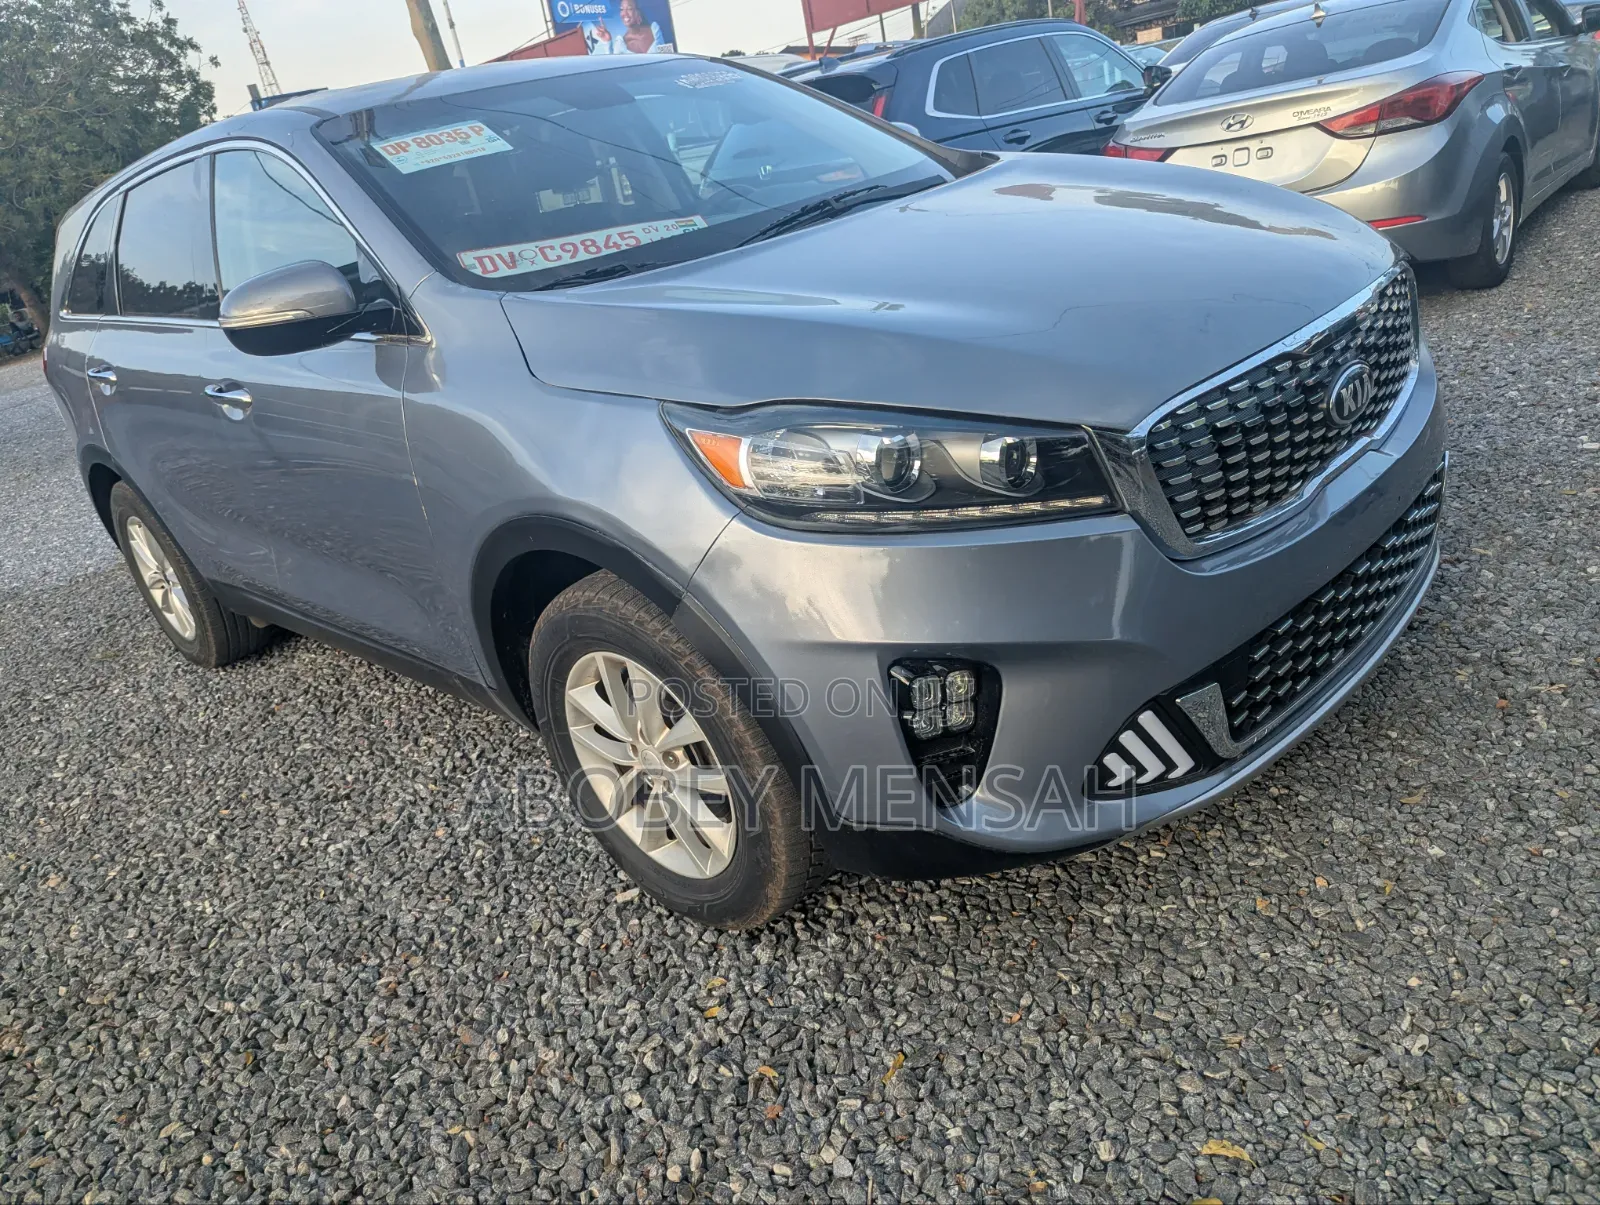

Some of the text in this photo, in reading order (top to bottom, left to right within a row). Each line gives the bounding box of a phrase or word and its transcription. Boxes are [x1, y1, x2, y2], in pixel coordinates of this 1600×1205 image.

[573, 3, 607, 14] BONUSES
[380, 140, 411, 157] DP
[411, 128, 472, 149] 8035
[468, 125, 484, 137] P
[642, 225, 659, 234] DV
[473, 230, 641, 275] DV C9845
[1340, 372, 1372, 417] KIA
